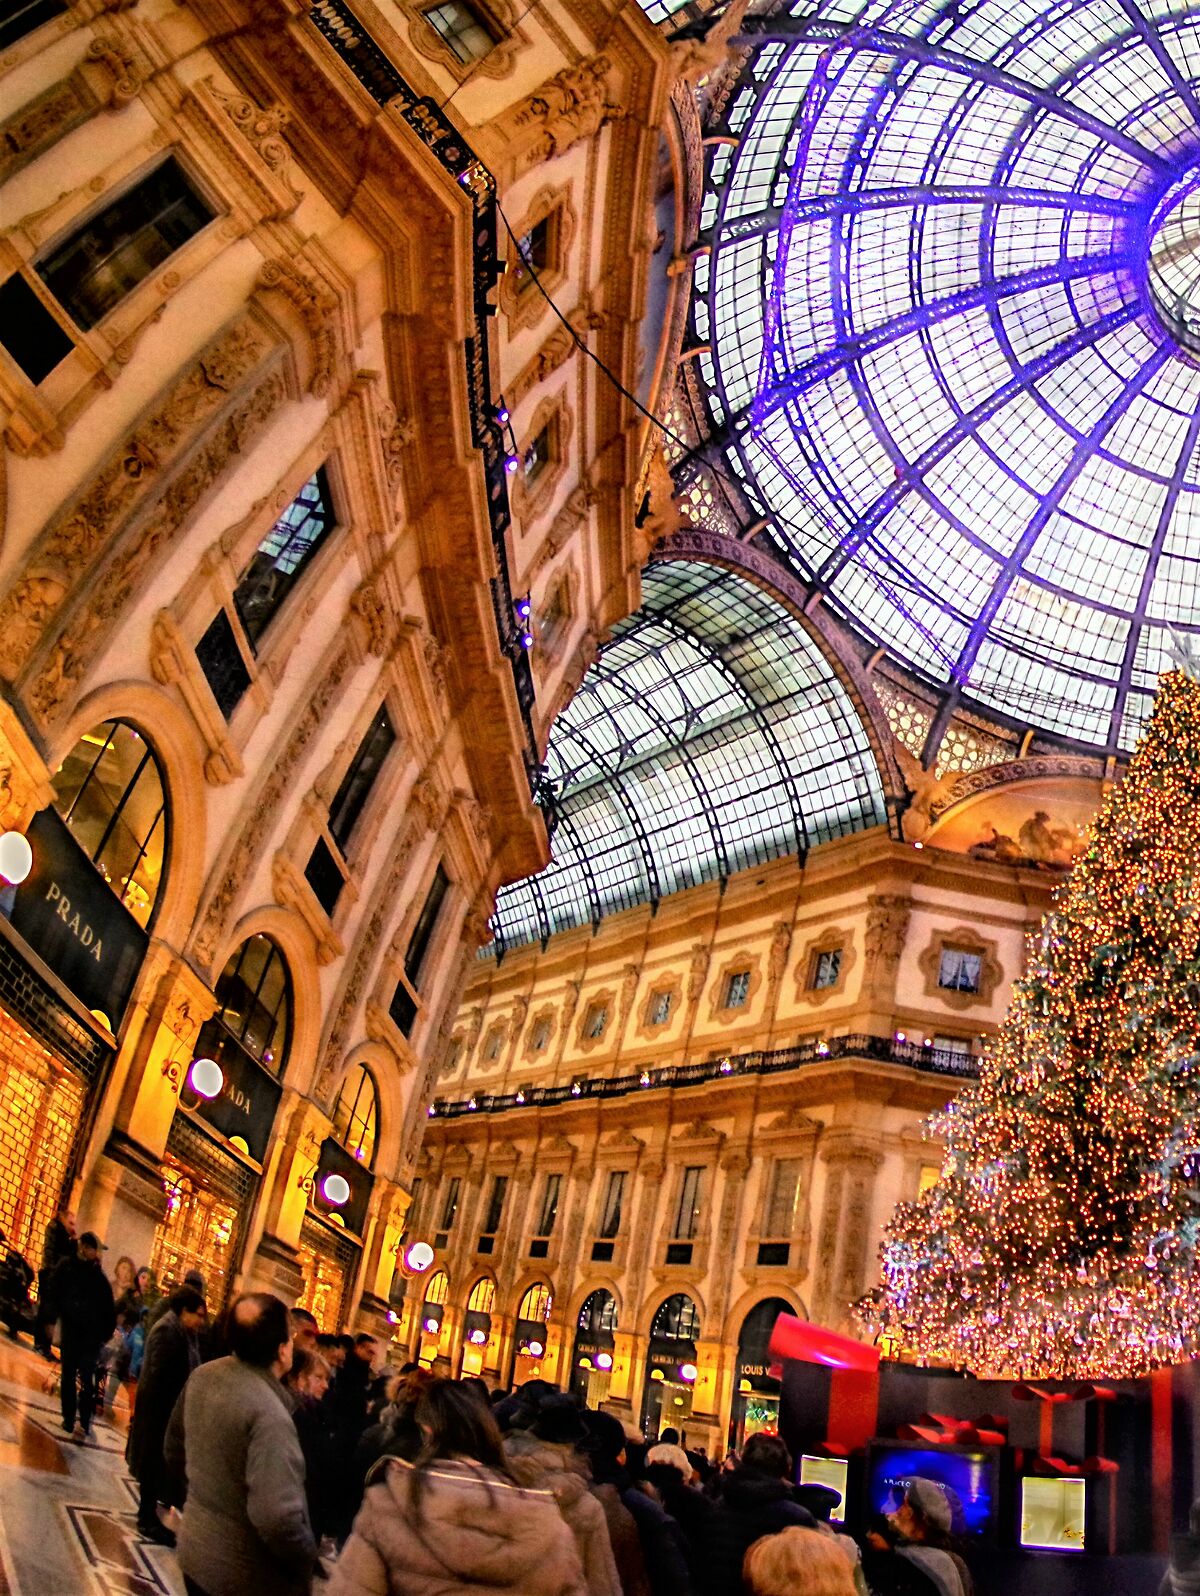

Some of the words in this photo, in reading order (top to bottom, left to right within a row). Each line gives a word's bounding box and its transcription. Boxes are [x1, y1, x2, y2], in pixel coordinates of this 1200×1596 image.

[46, 881, 102, 962] PRADA
[225, 1084, 250, 1115] ADA
[741, 1364, 763, 1376] LOUIS
